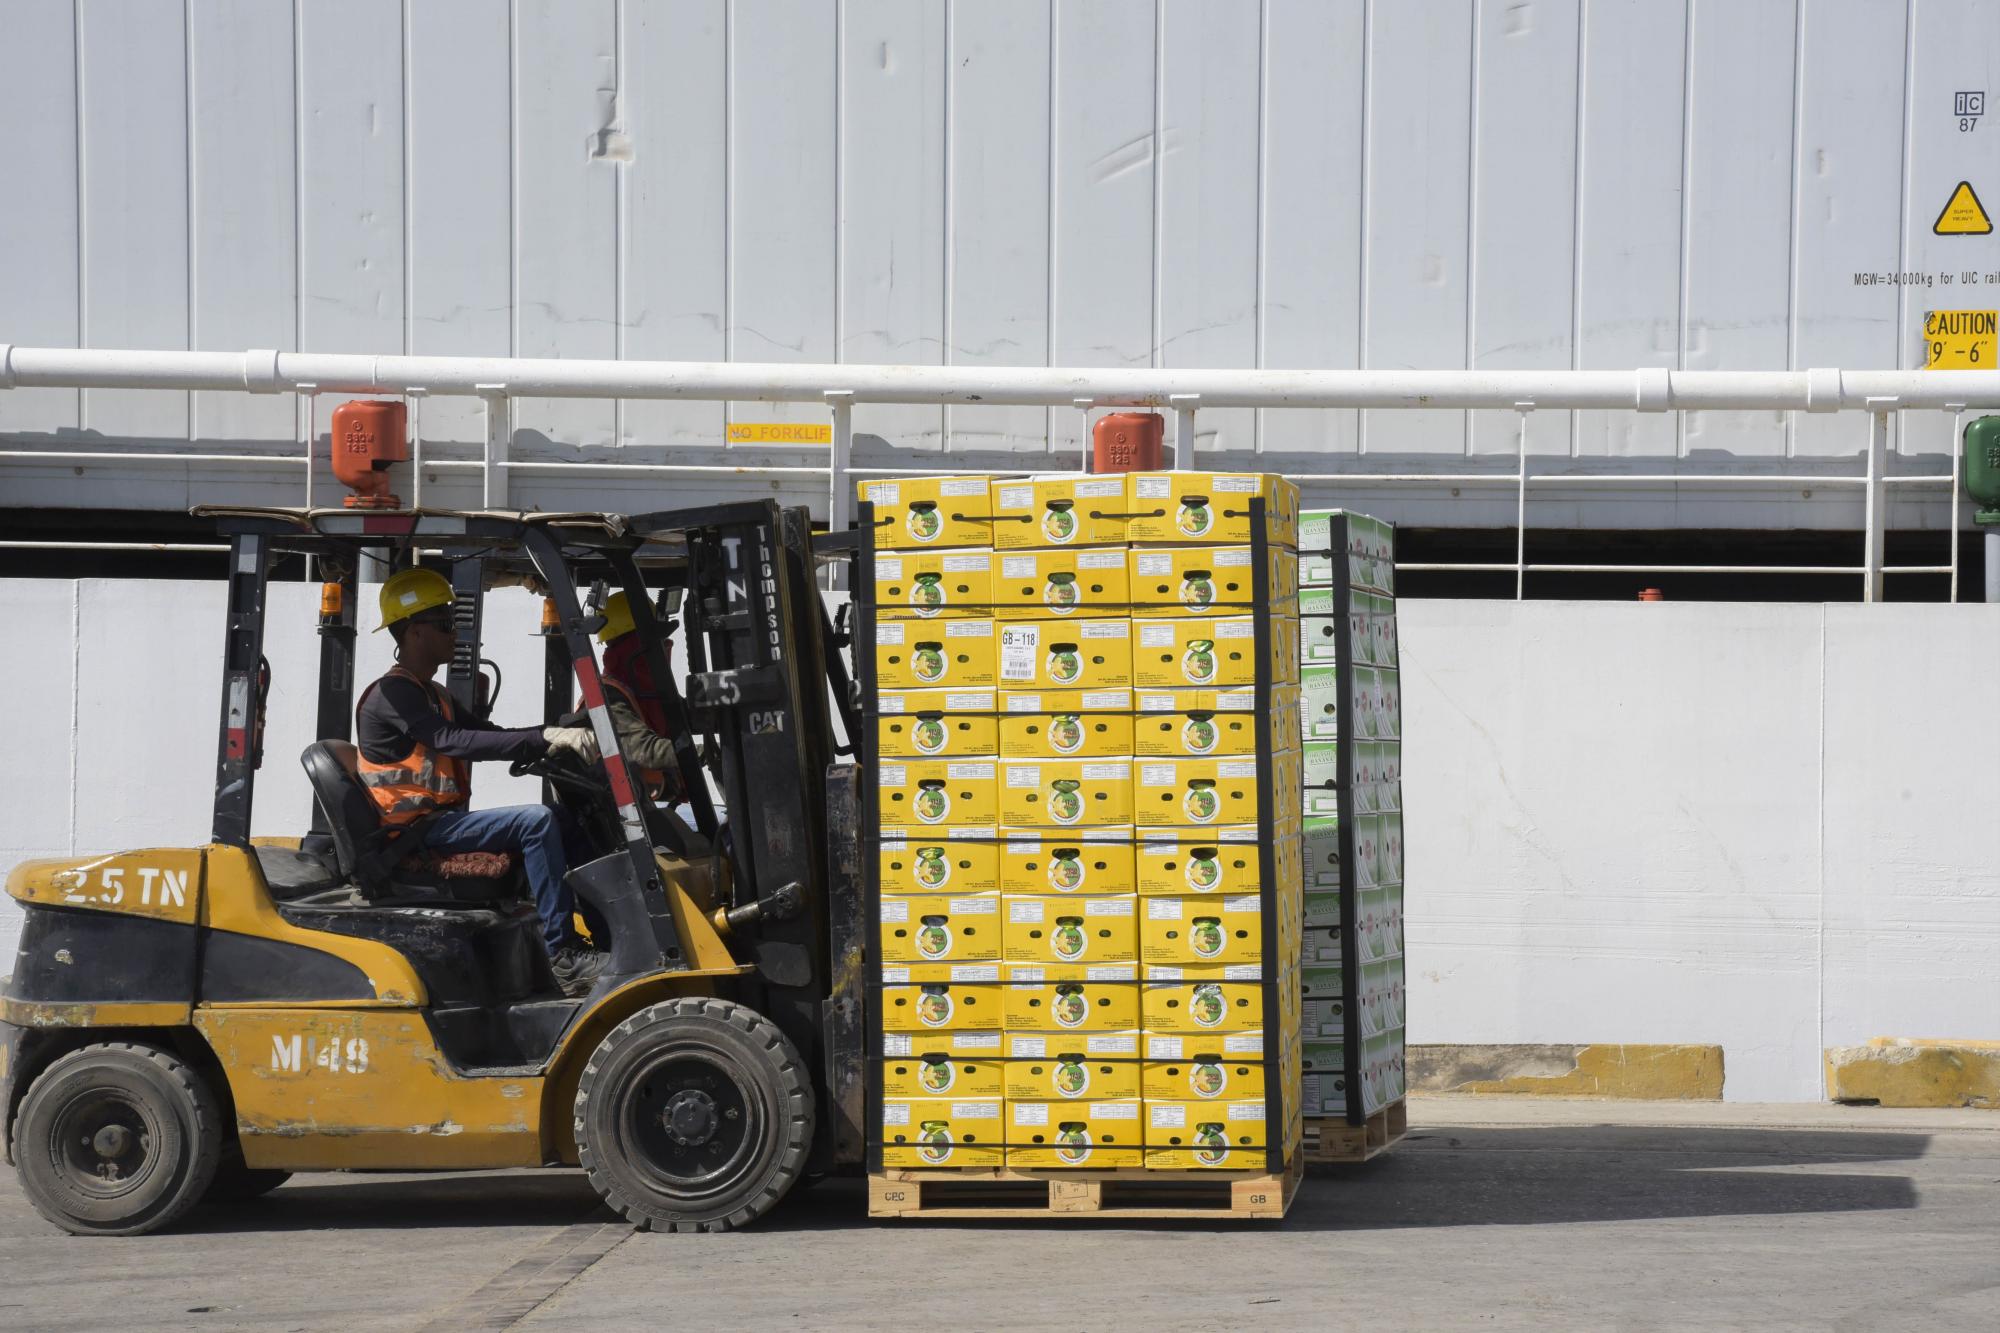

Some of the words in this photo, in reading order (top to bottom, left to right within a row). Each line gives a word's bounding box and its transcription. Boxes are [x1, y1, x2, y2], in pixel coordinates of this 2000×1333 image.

[1959, 117, 1978, 132] 87
[1940, 271, 1954, 285] for
[1961, 271, 1978, 285] UIC
[1926, 312, 1996, 335] CAUTION
[730, 426, 752, 439] NO
[760, 426, 832, 440] FORKLIF
[756, 525, 781, 661] Thompson
[749, 710, 785, 735] CAT
[137, 867, 188, 907] TN
[1250, 1194, 1267, 1204] GB
